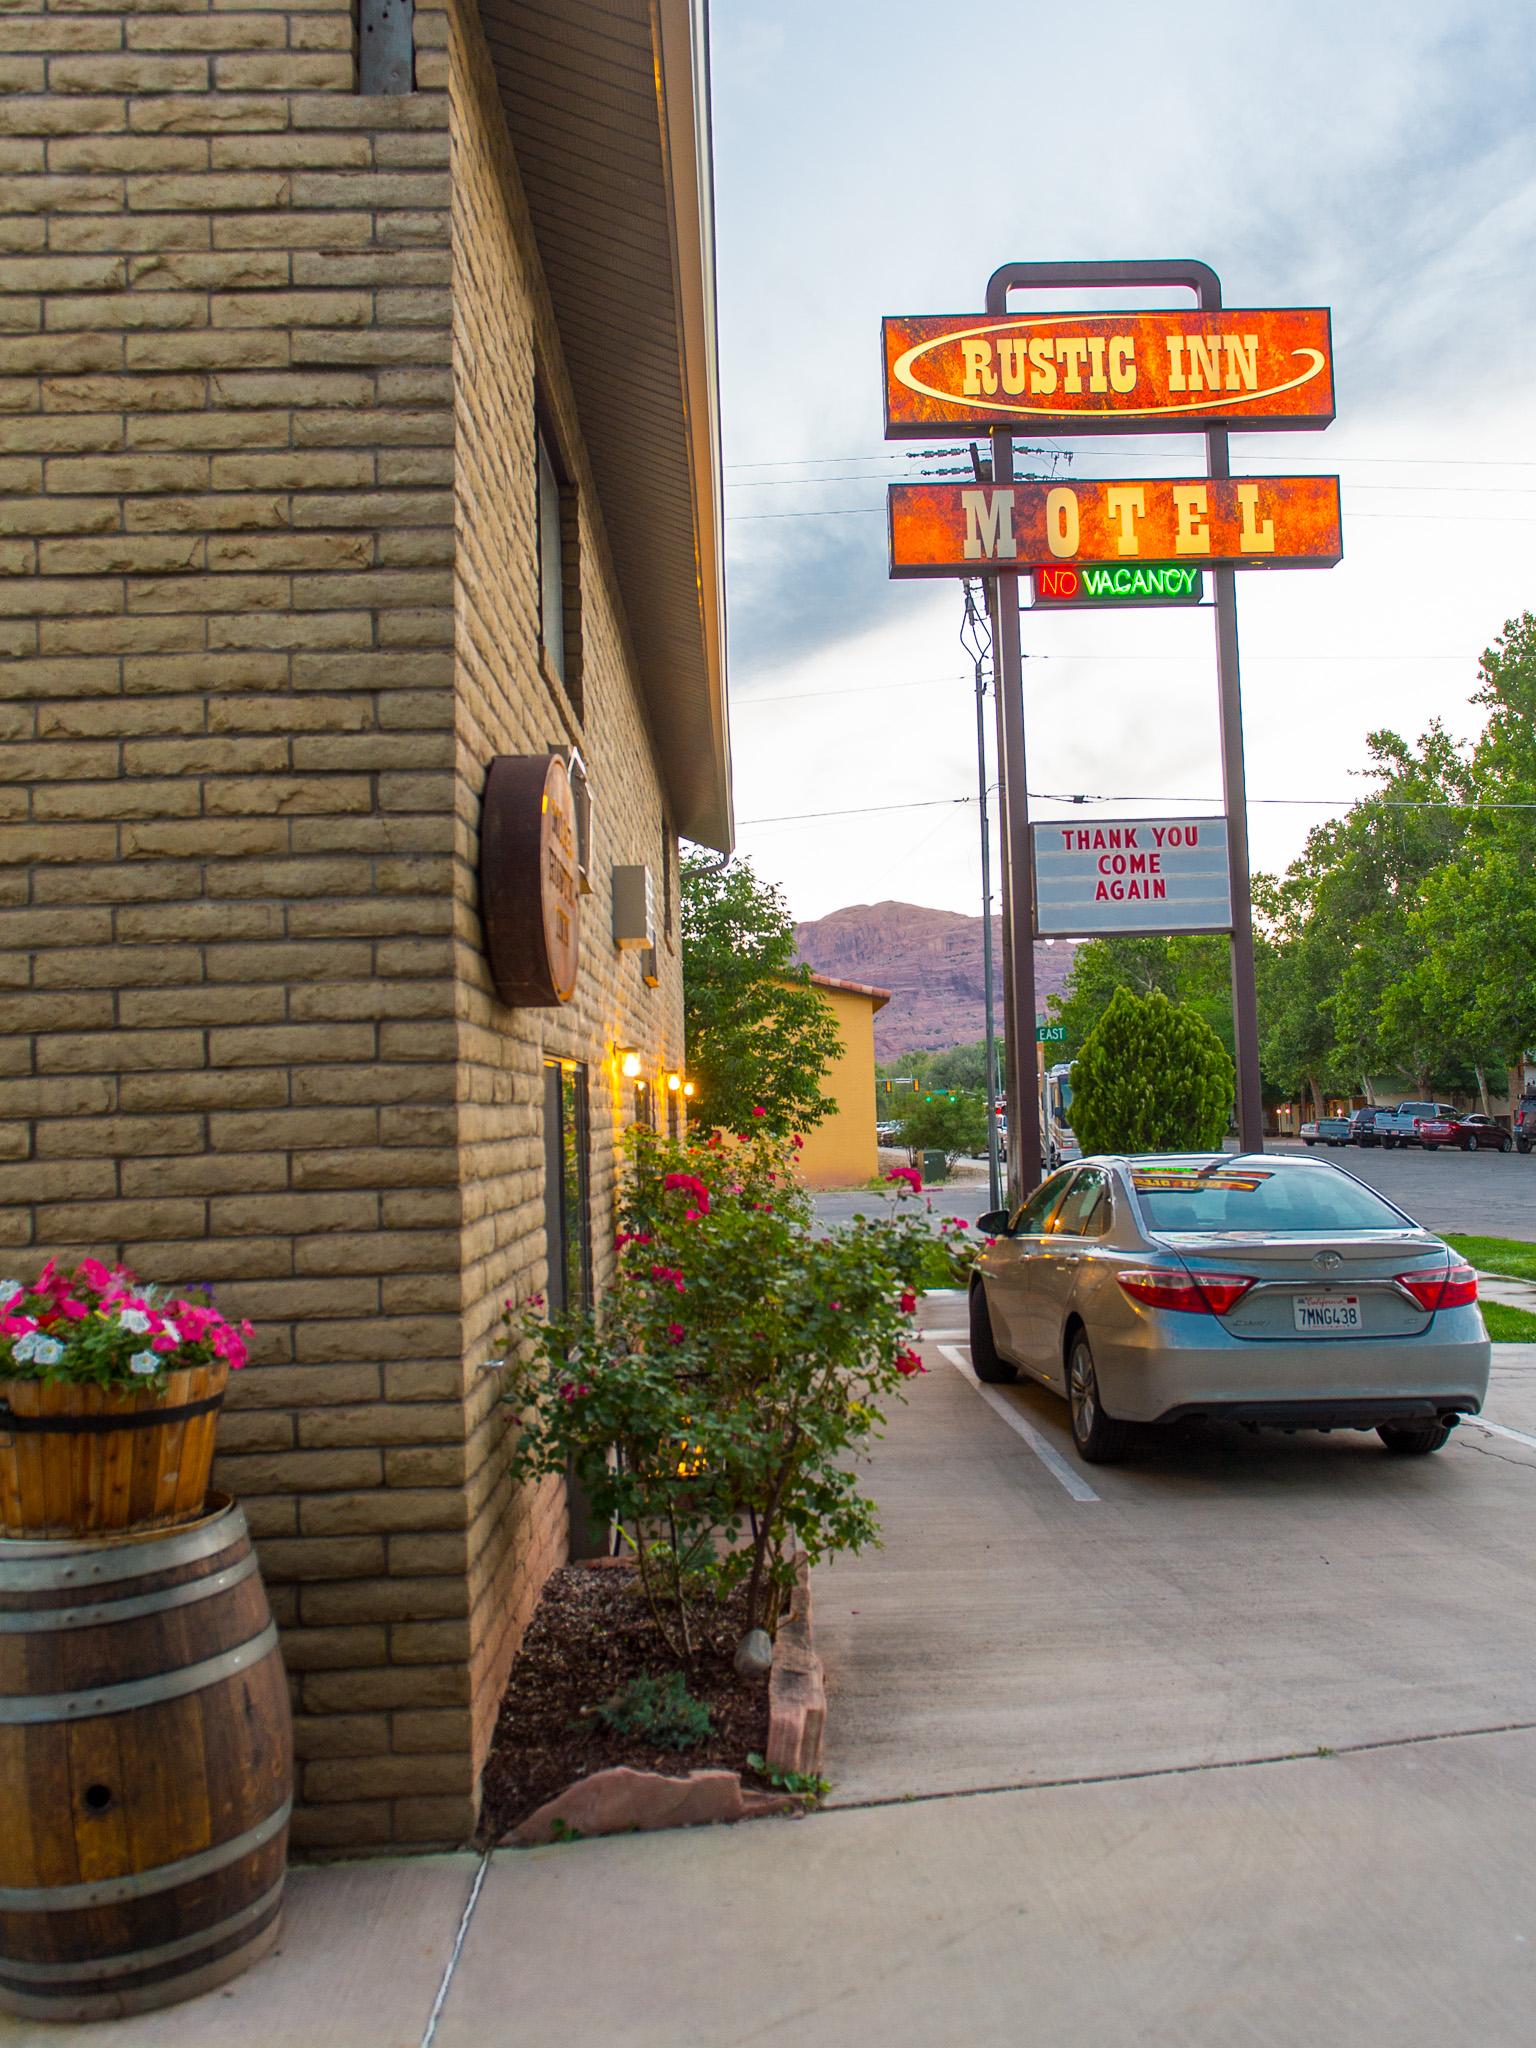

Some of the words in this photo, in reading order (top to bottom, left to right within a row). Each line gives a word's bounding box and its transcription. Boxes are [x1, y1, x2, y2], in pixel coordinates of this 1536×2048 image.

[961, 336, 1137, 396] RUSTIC
[1165, 334, 1259, 392] INN
[961, 484, 1275, 559] MOTEL
[1042, 570, 1078, 595] NO
[1082, 569, 1197, 595] VACANCY
[1062, 828, 1138, 850] THANK
[1152, 826, 1199, 847] YOU
[1098, 854, 1161, 875] COME
[1095, 879, 1166, 900] AGAIN
[1039, 1027, 1064, 1040] EAST
[1298, 1307, 1358, 1326] 7MNG438
